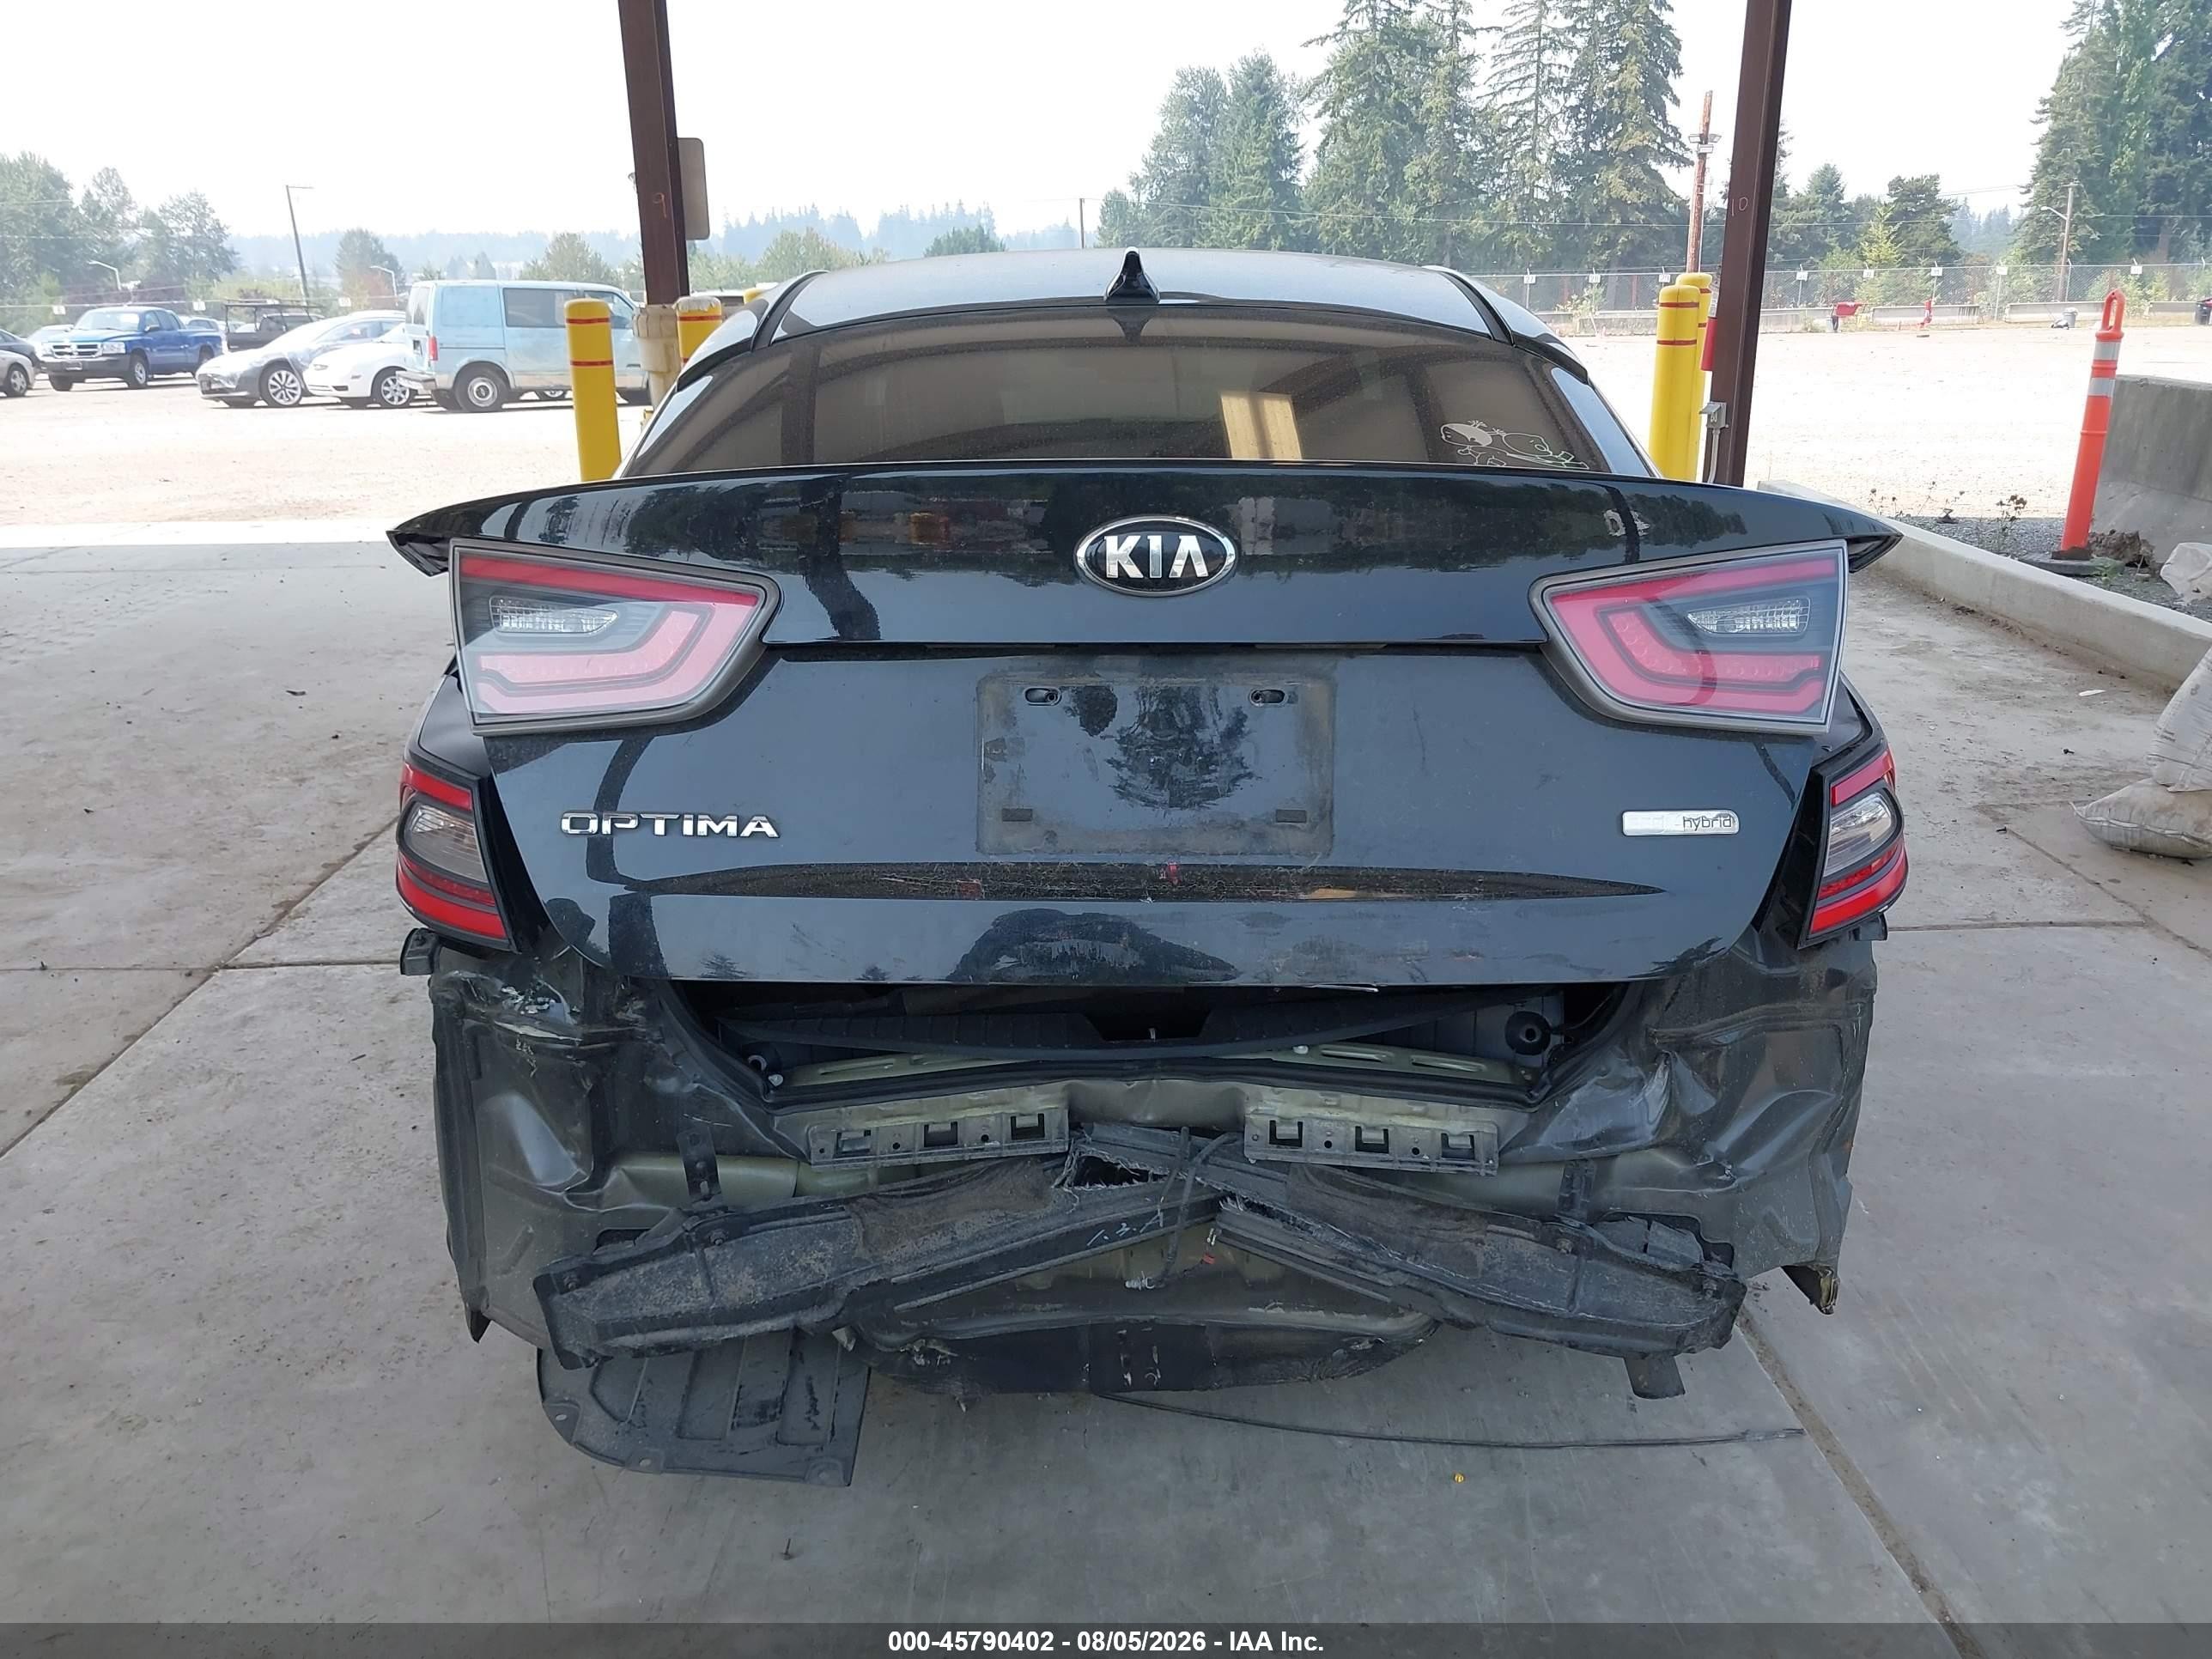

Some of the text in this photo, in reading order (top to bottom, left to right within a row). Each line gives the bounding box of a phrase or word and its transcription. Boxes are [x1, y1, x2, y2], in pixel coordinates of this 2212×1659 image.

[1103, 535, 1209, 579] KIA
[561, 812, 780, 838] OPTIMA
[1682, 815, 1733, 832] hybrid
